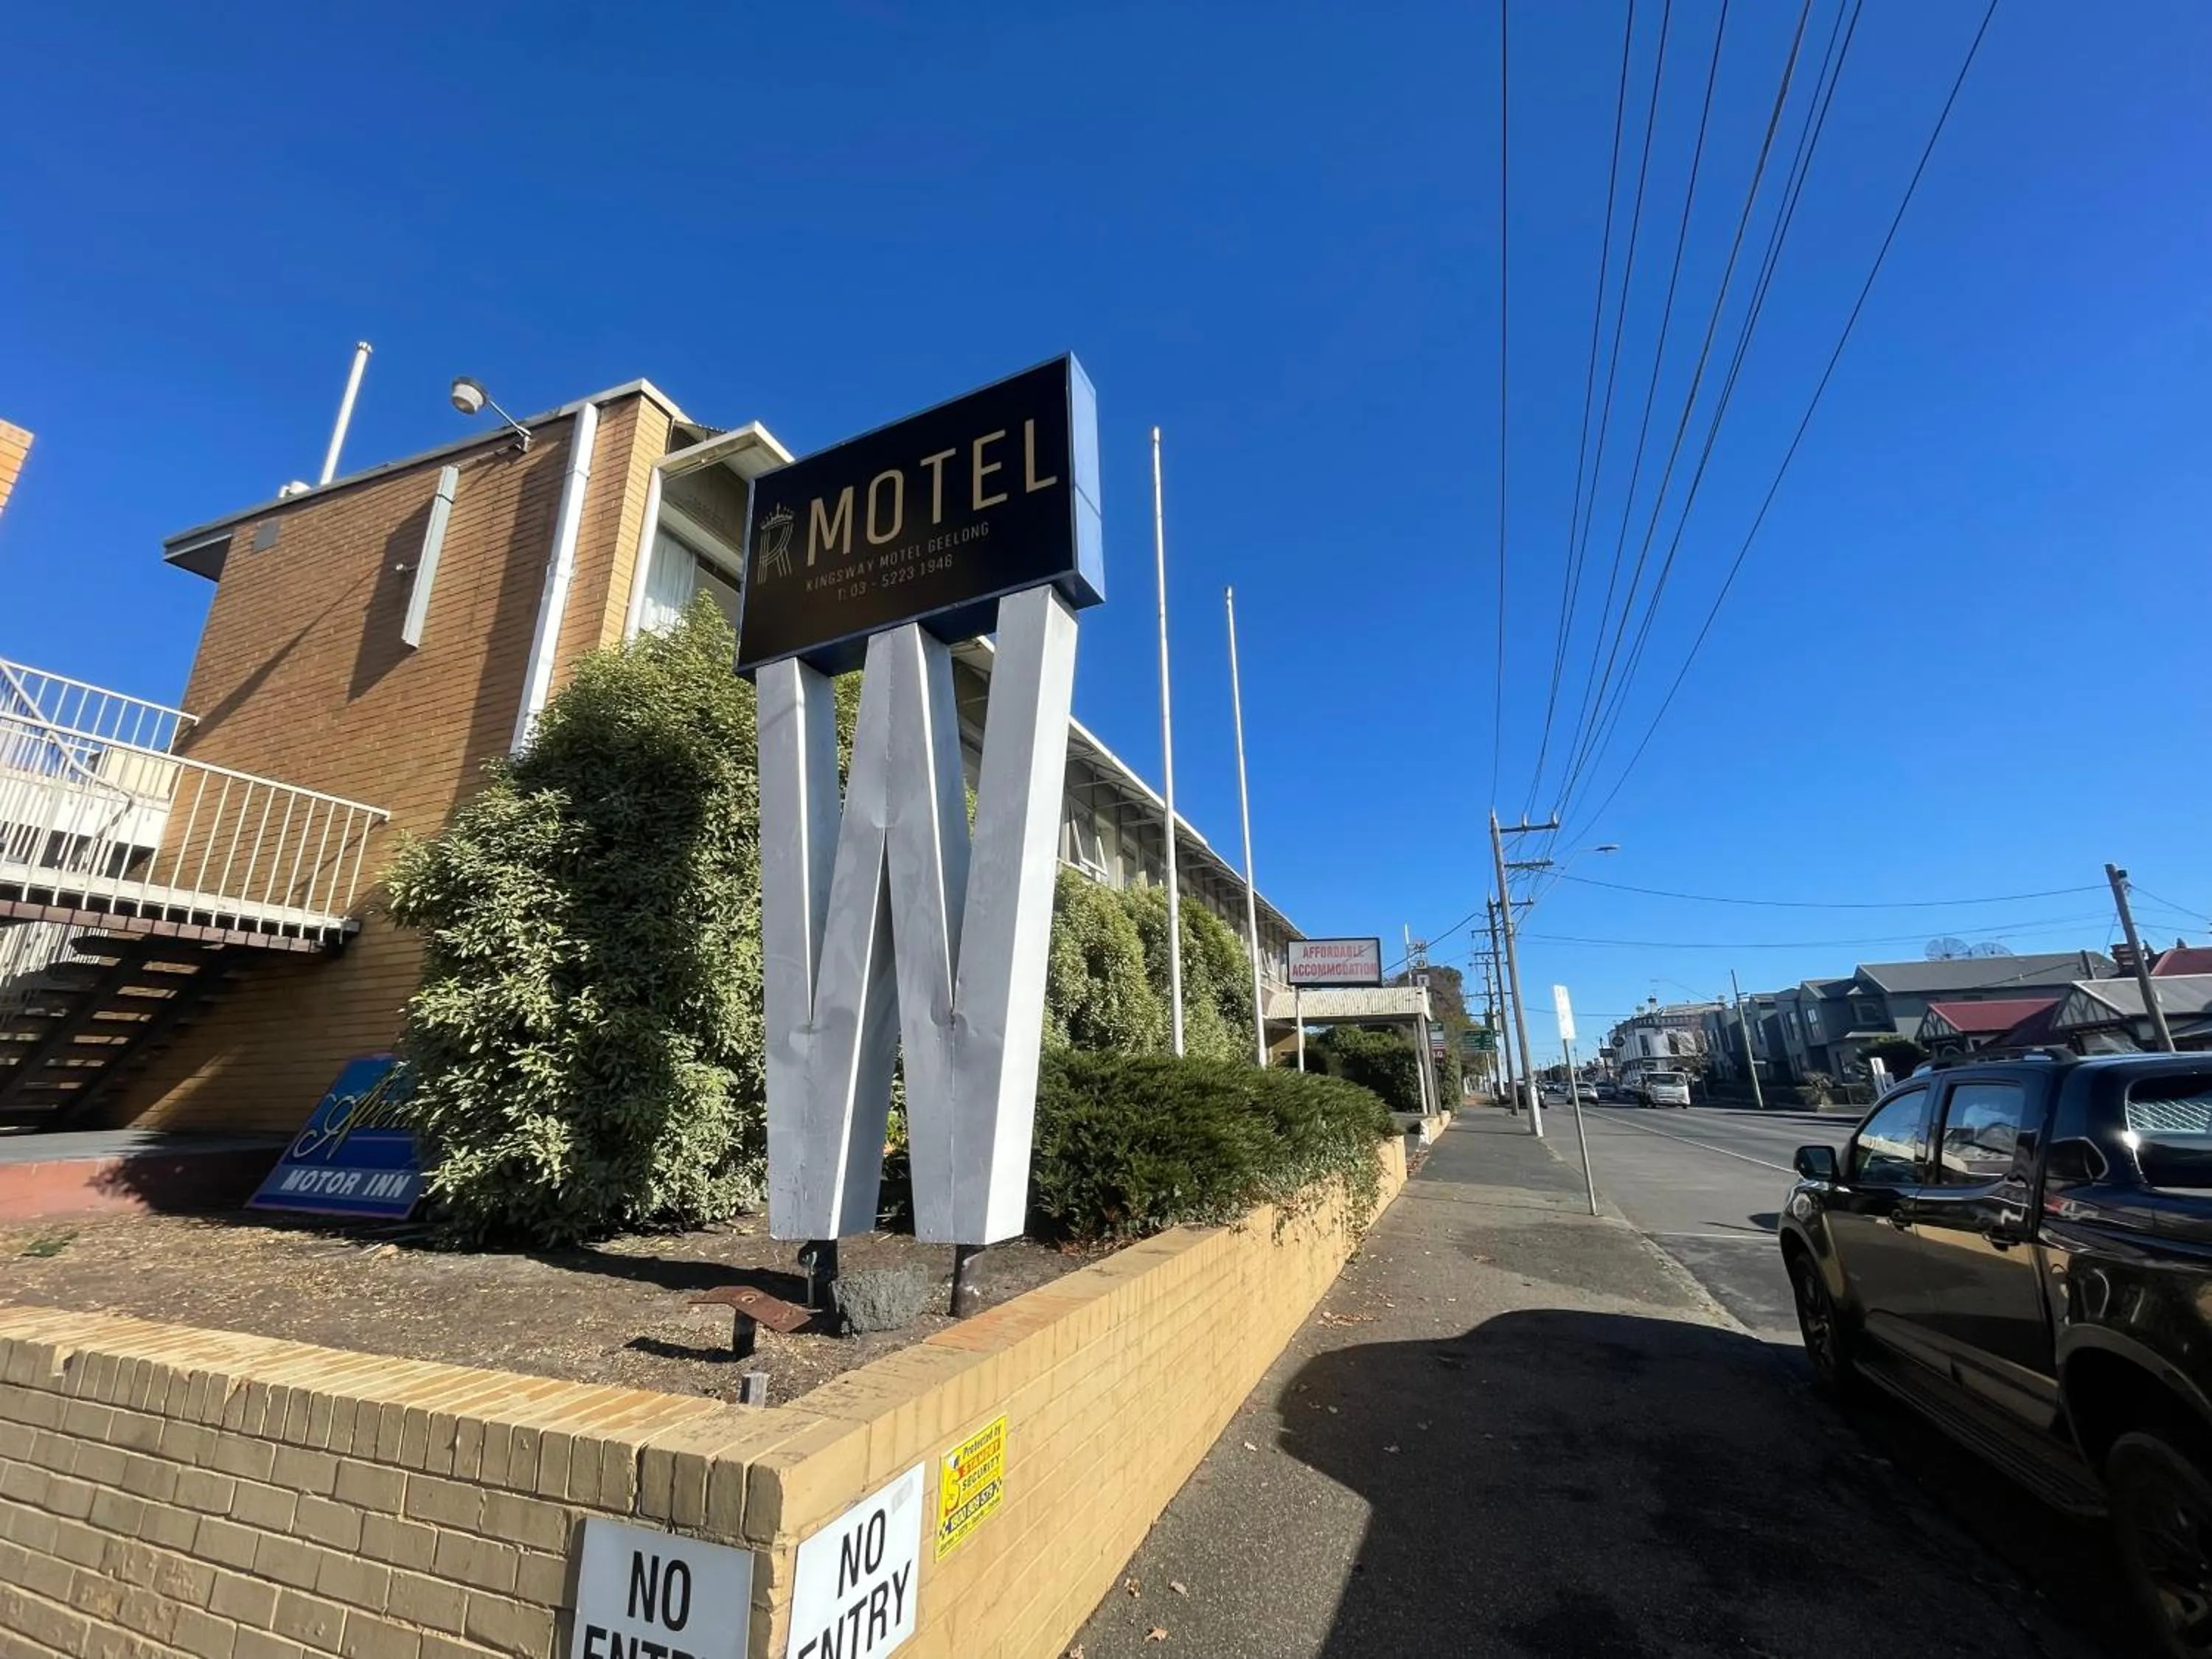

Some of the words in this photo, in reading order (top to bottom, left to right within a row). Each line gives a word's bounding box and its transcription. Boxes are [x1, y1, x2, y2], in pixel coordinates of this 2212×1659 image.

[807, 418, 1057, 566] MOTEL
[805, 559, 874, 592] KINGSWAY
[880, 545, 921, 568] MOTEL
[928, 522, 990, 554] GEELONG
[850, 581, 866, 599] 03
[882, 566, 914, 588] 5223
[1292, 962, 1377, 977] ACCOMMODATION
[1303, 945, 1366, 959] AFFORDABLE
[280, 1169, 362, 1197] MOTOR
[362, 1174, 413, 1199] INN
[962, 1452, 1001, 1492] SECURITY
[837, 1508, 886, 1600] NO
[627, 1550, 692, 1632] NO
[798, 1559, 912, 1659] NTRY
